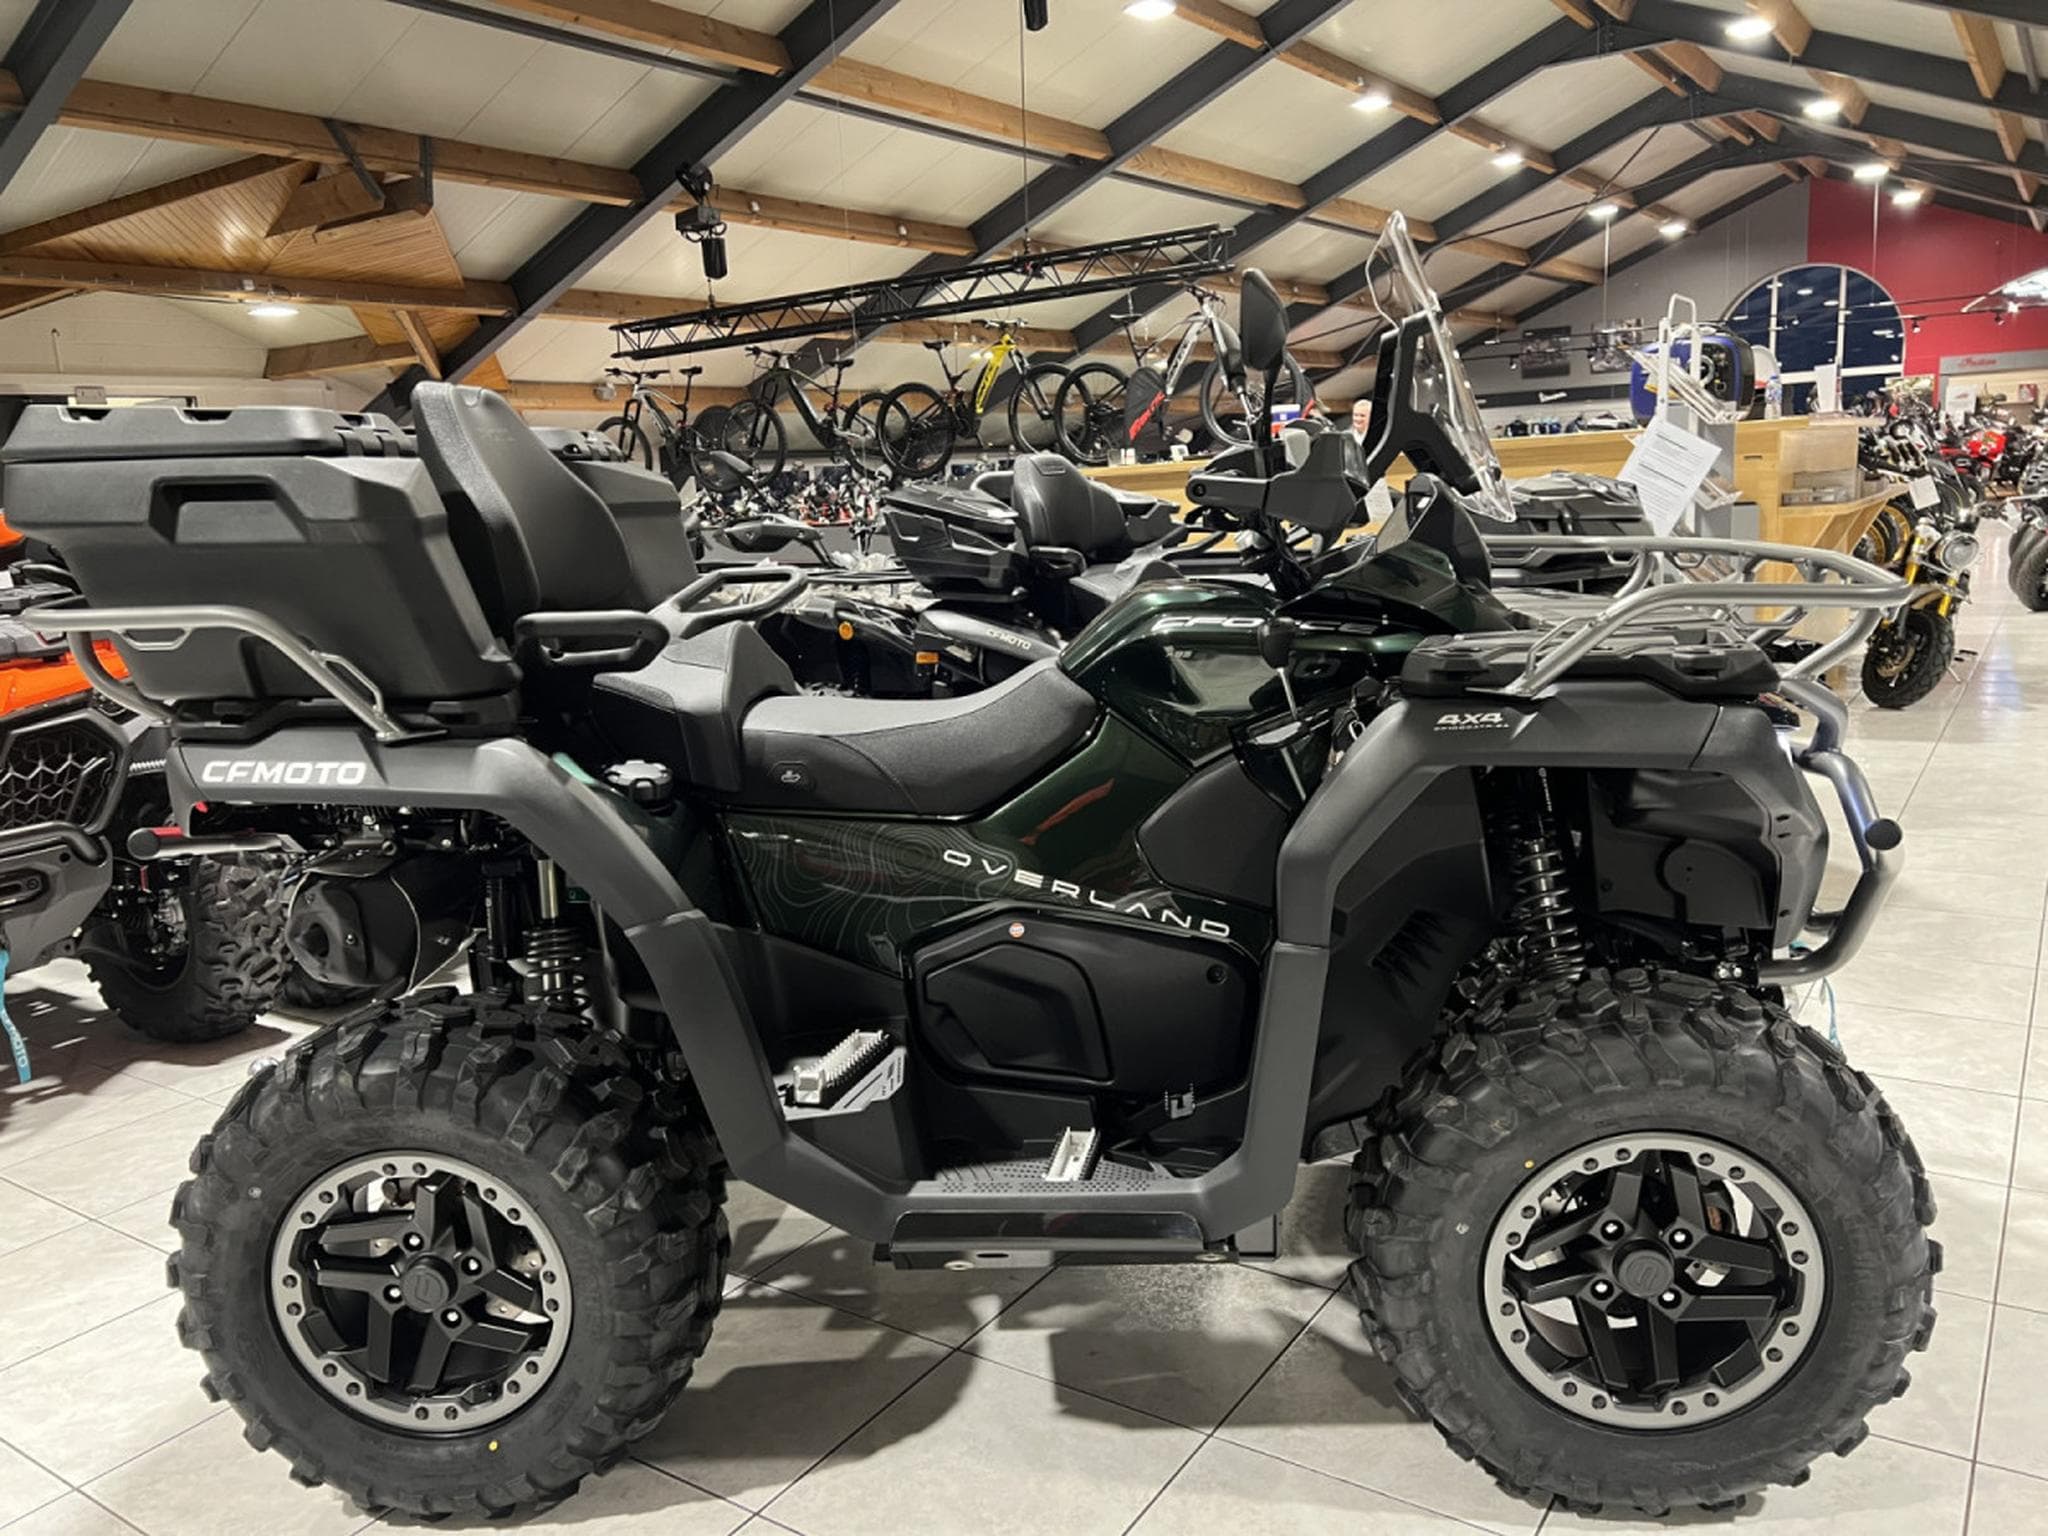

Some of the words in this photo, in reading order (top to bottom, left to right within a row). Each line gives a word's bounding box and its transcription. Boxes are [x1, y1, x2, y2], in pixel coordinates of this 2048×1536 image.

[1150, 616, 1378, 635] CFOCE
[201, 760, 367, 786] CFMOTO
[943, 849, 1231, 938] OVERLAND
